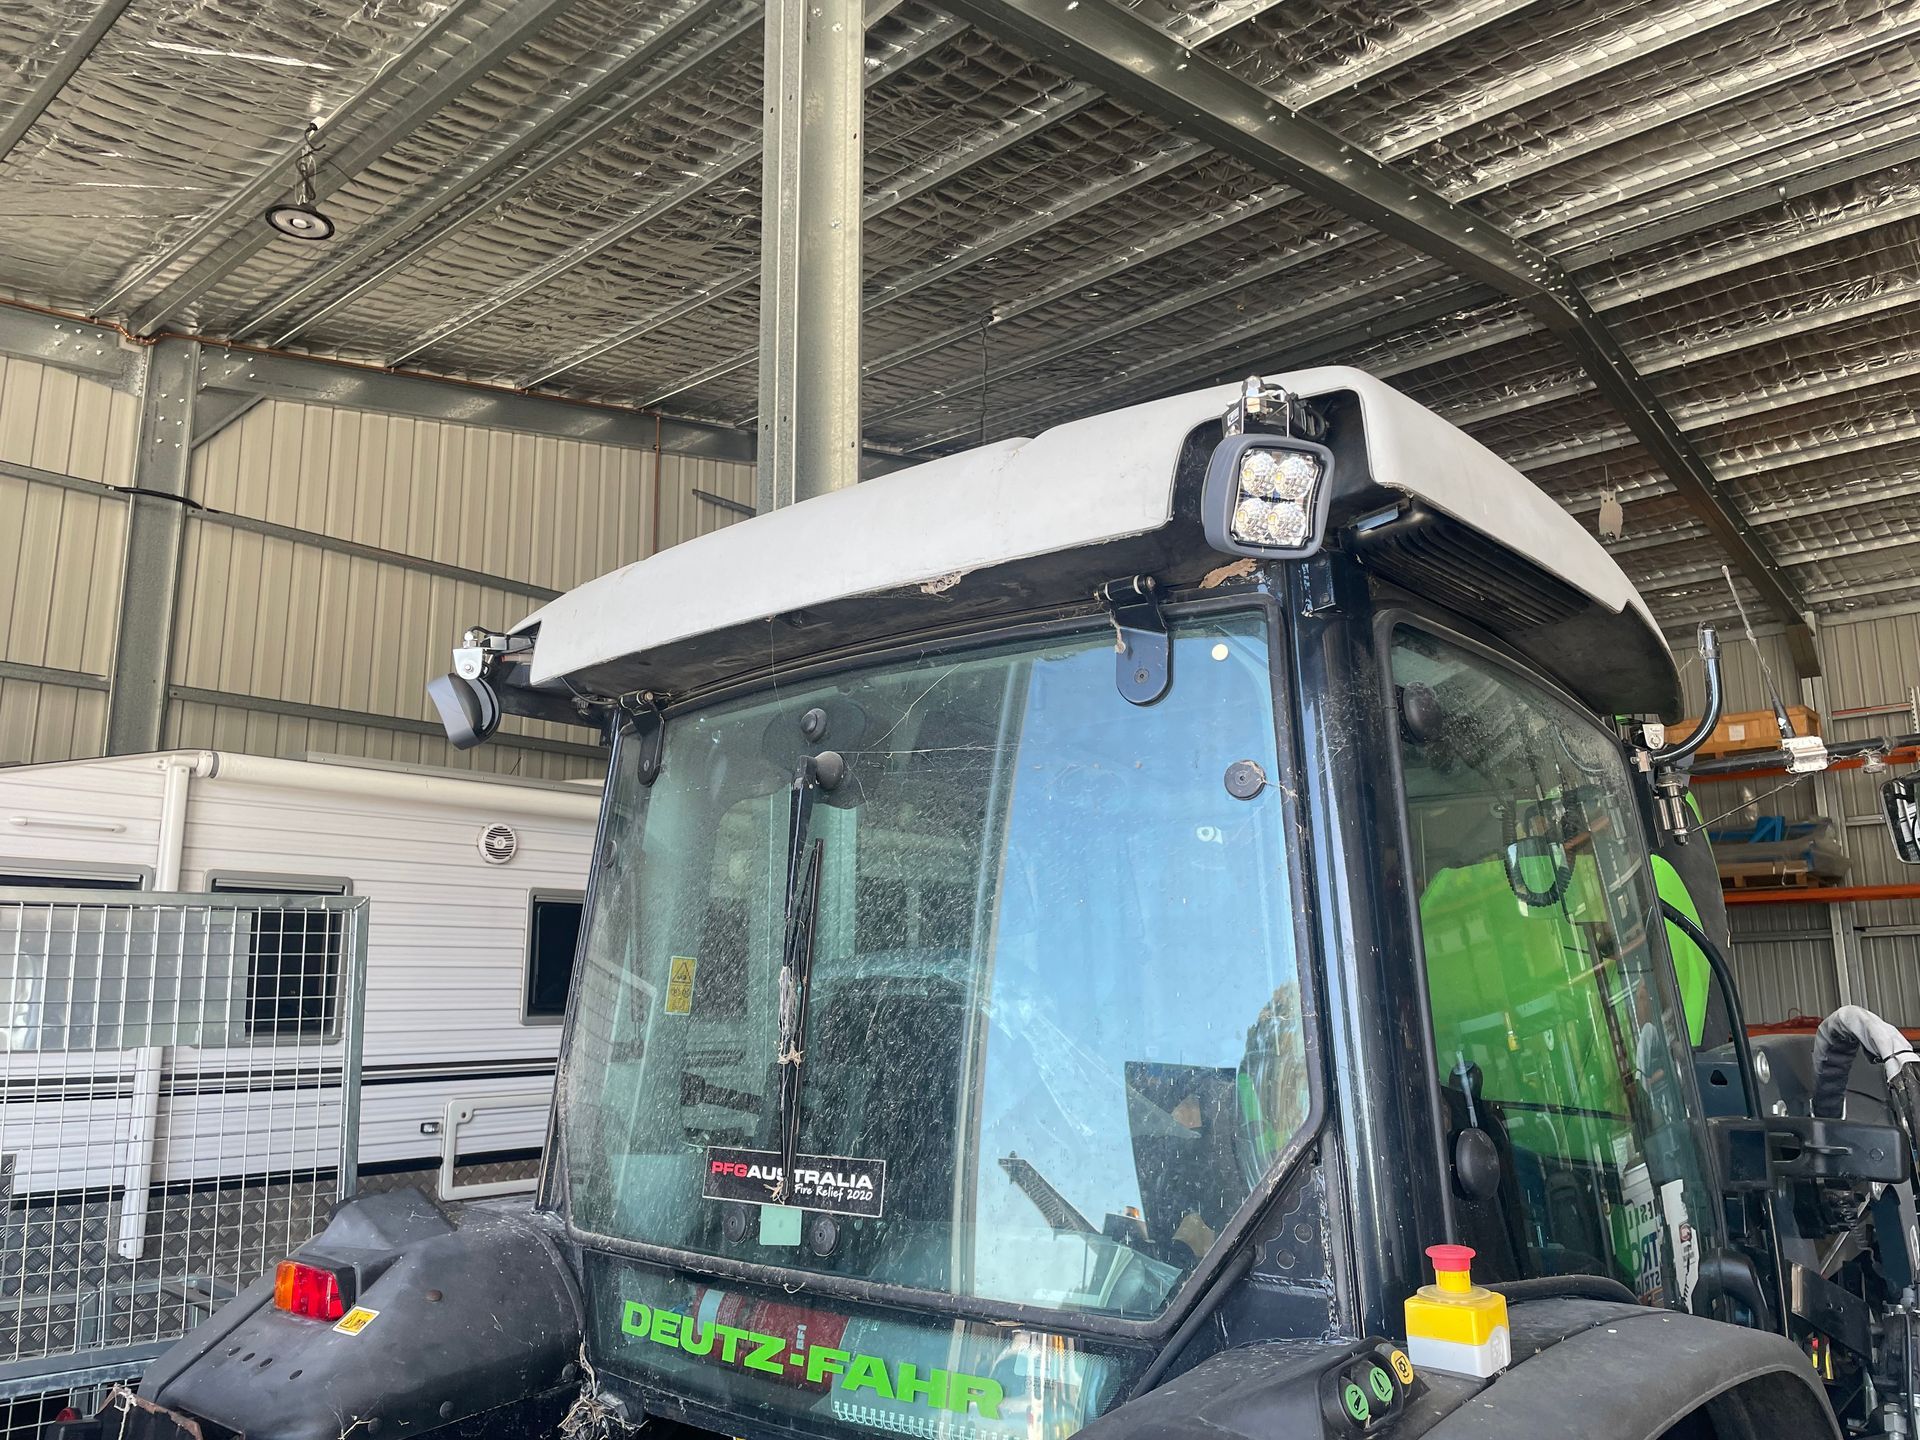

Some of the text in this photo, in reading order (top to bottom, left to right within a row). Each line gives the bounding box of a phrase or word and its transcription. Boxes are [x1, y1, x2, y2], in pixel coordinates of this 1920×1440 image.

[794, 1182, 873, 1203] Fire Relief 2020
[622, 1301, 1003, 1418] DEUTZ-FAHR
